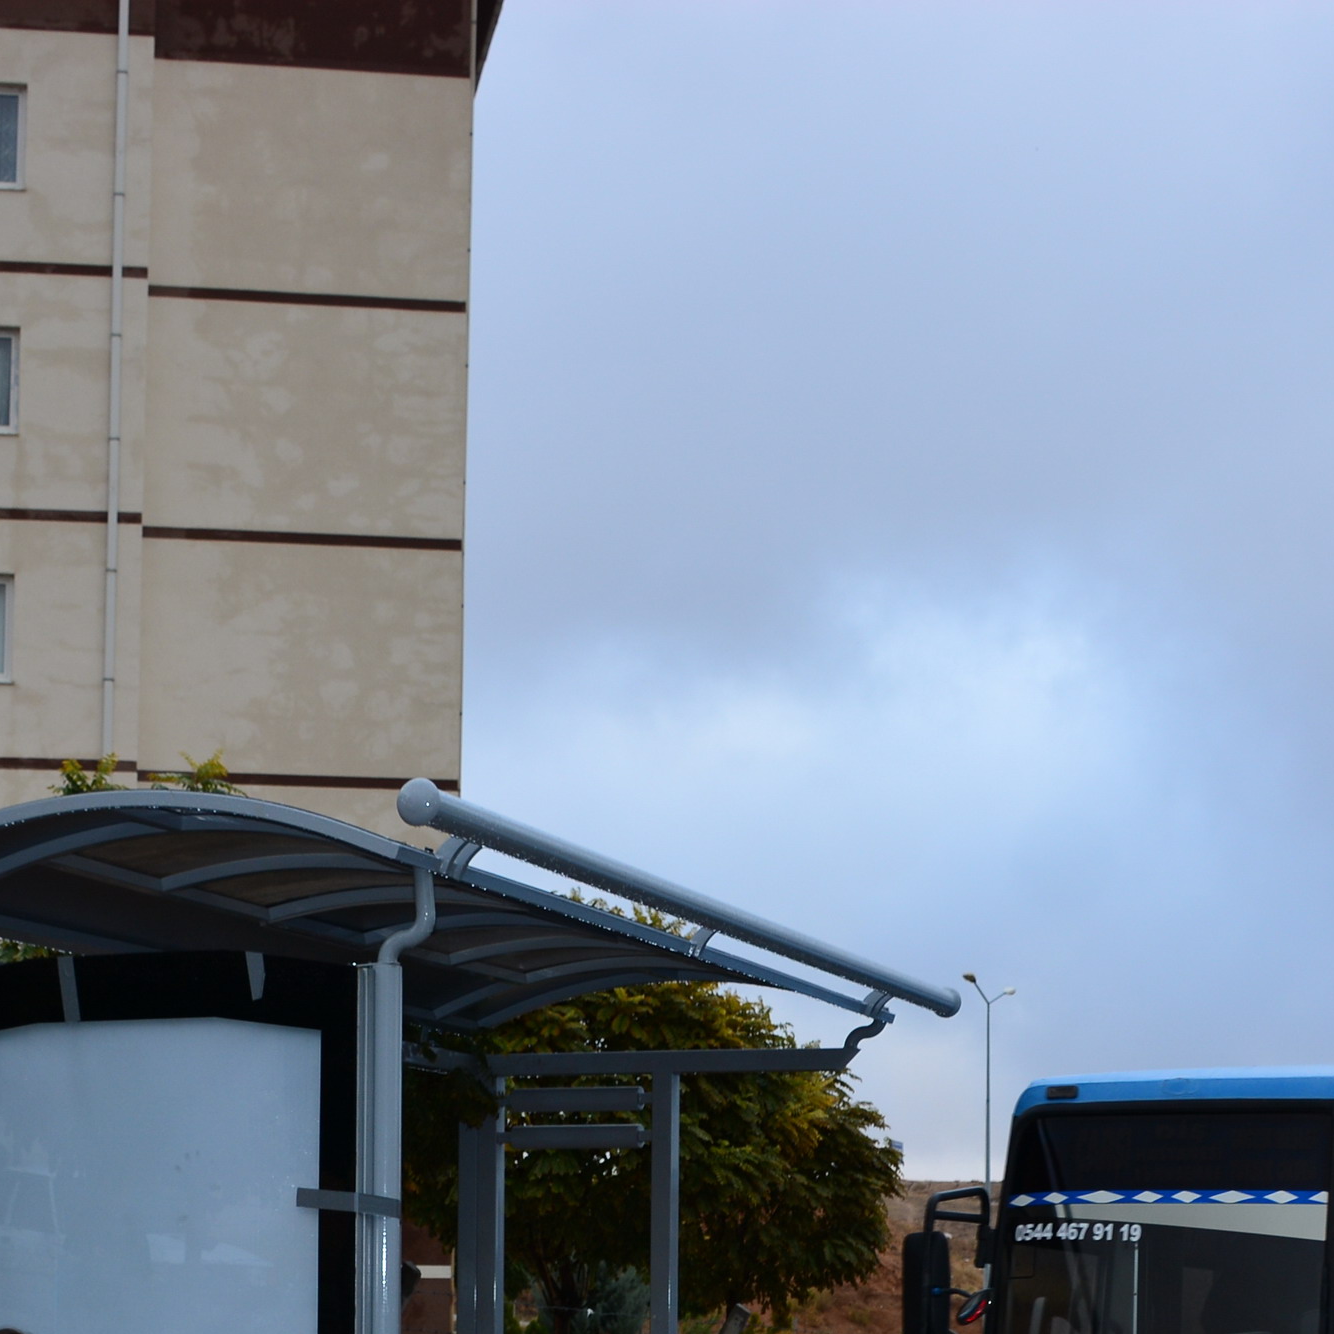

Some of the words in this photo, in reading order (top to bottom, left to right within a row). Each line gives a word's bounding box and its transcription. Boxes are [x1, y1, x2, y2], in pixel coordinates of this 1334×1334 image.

[1014, 1222, 1054, 1242] 0544
[1056, 1222, 1089, 1241] 467
[1092, 1222, 1114, 1241] 91
[1119, 1223, 1142, 1242] 19
